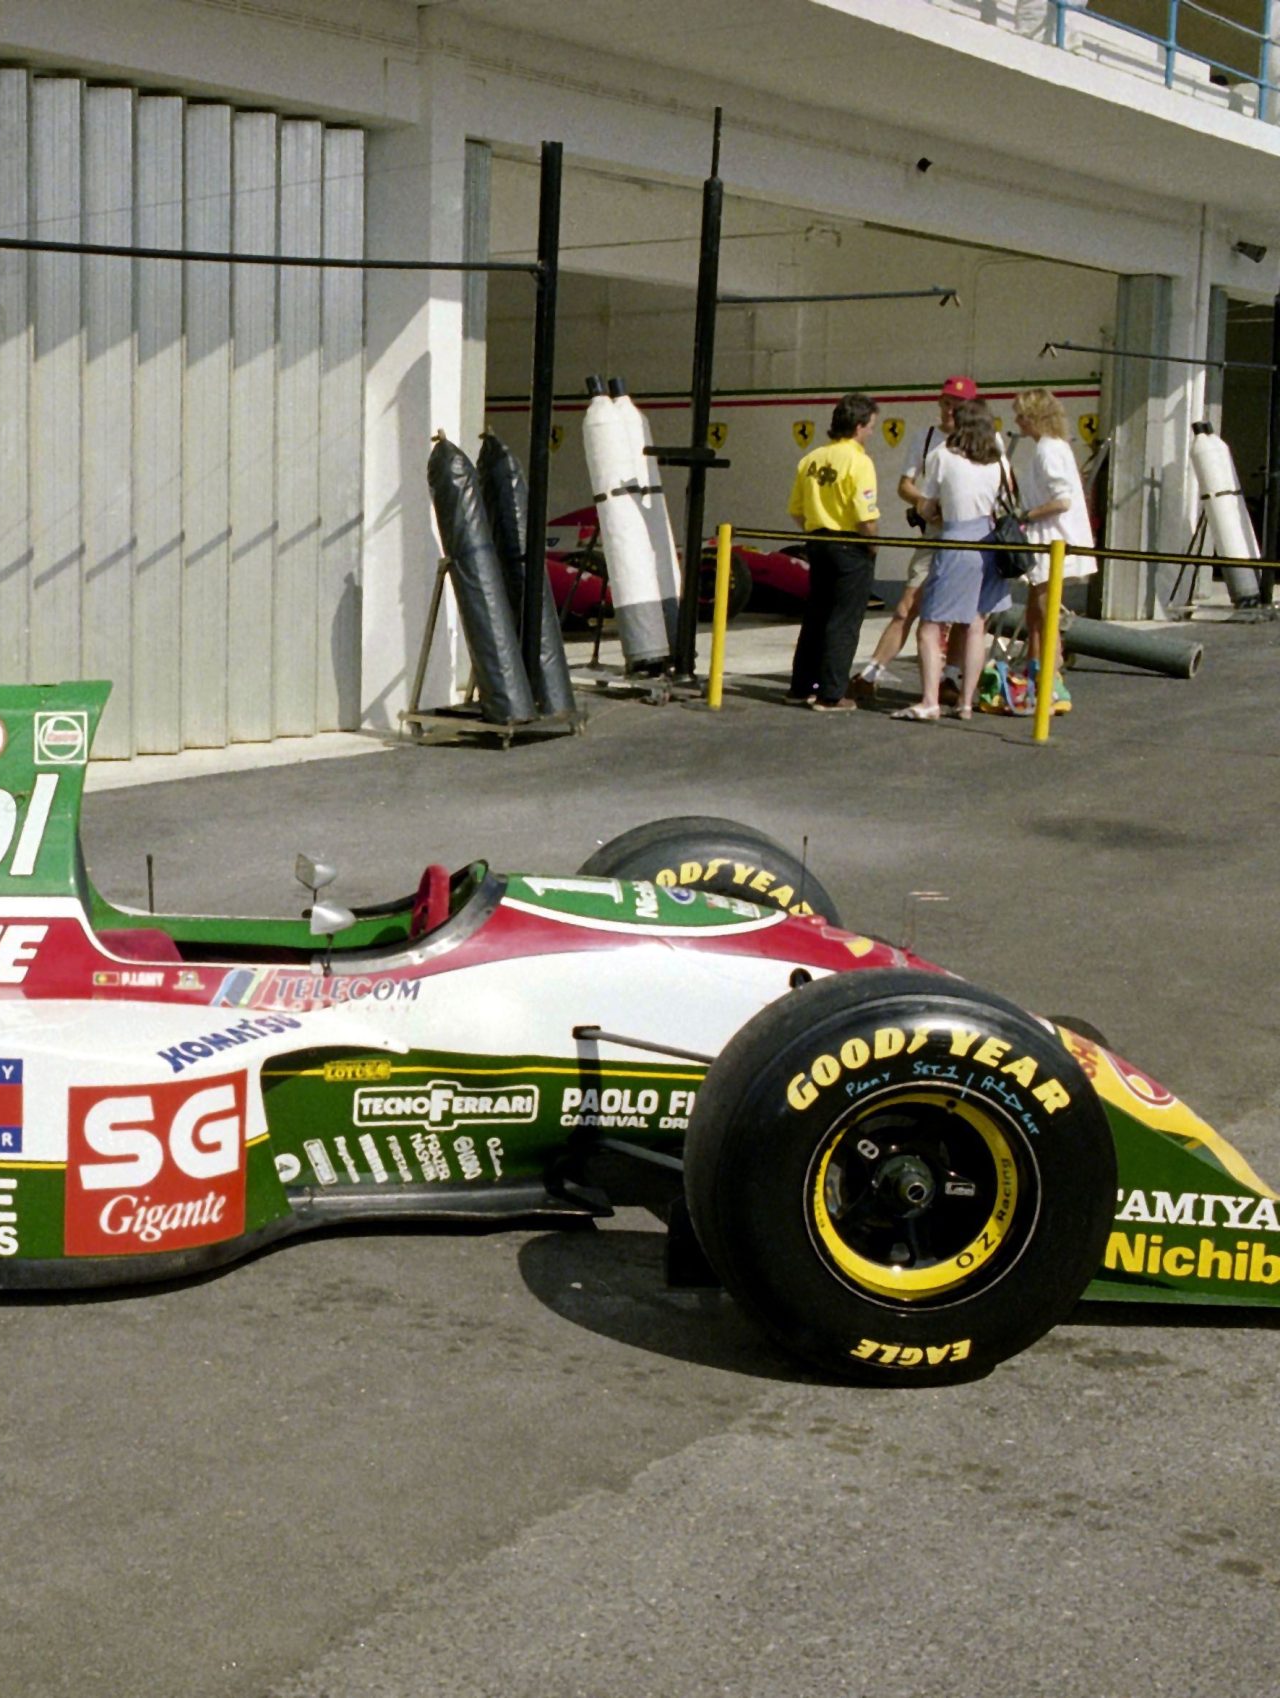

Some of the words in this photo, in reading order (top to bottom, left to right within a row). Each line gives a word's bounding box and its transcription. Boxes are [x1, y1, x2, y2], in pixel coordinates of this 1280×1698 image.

[274, 975, 421, 1002] TELECOM
[786, 1026, 1072, 1116] GOODYEAR
[561, 1087, 659, 1115] PAOLO
[668, 1090, 696, 1116] FI
[559, 1113, 649, 1128] CARNIVAL
[78, 1084, 241, 1190] SG
[99, 1191, 227, 1243] Gigante
[850, 1337, 973, 1367] EAGLE
